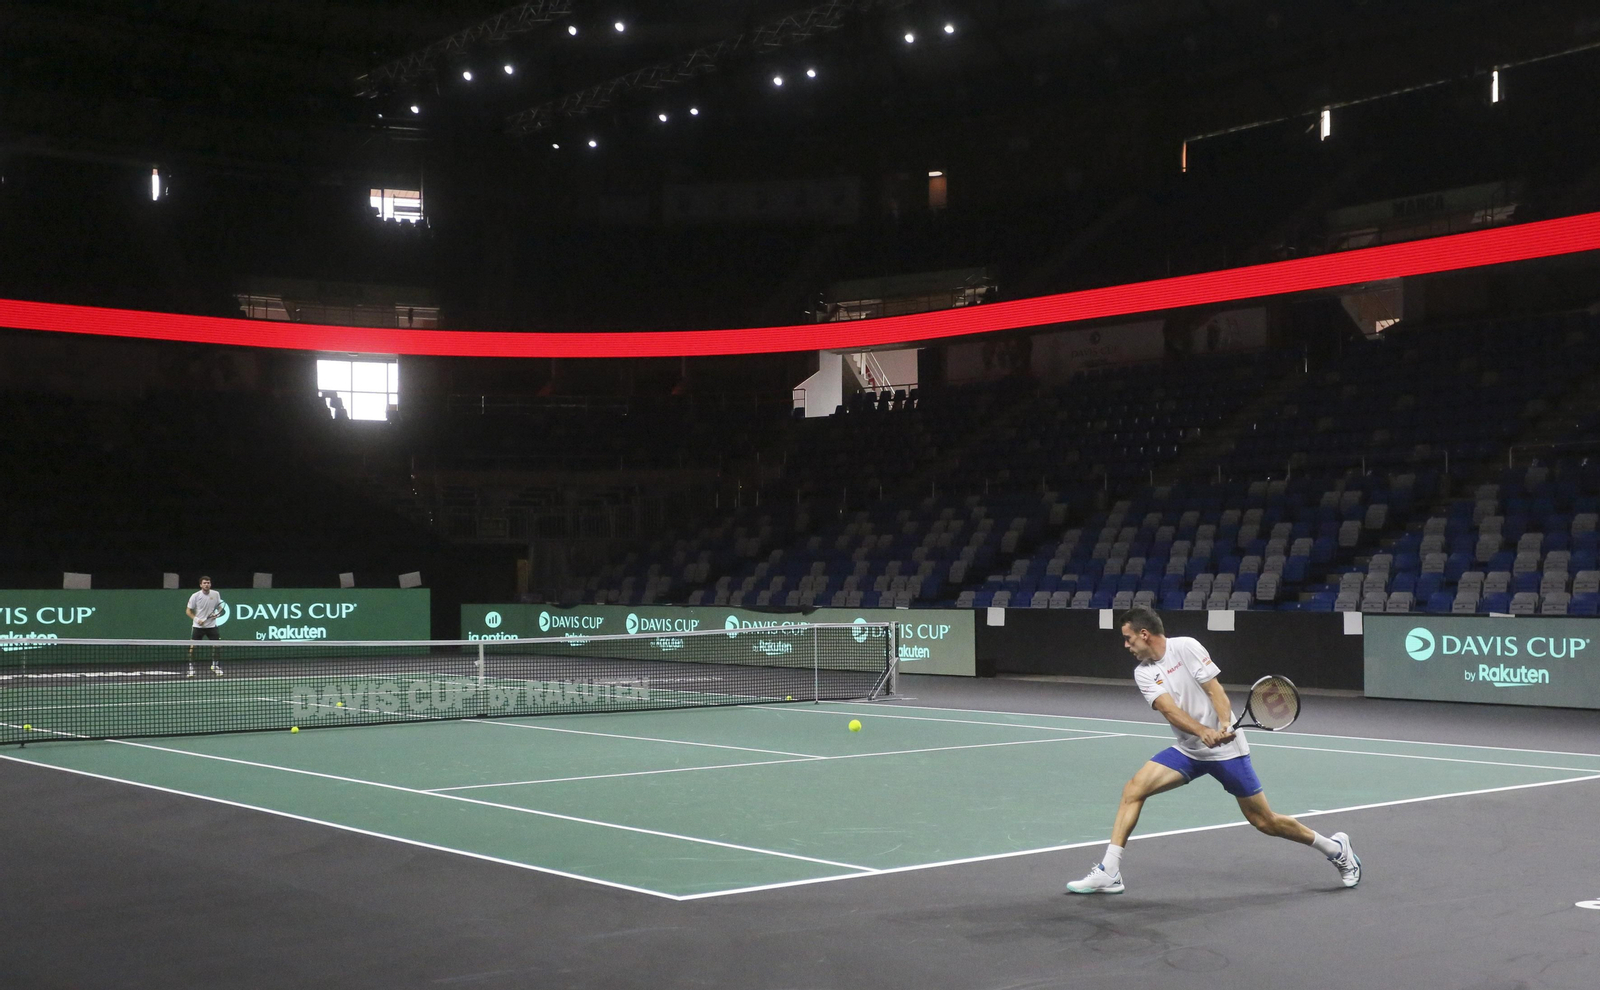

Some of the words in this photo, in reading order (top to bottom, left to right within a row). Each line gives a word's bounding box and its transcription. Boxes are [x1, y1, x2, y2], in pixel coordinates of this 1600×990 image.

[0, 607, 28, 625] IS
[36, 607, 92, 624] CUP
[236, 603, 302, 620] DAVIS
[308, 603, 355, 619] CUP
[552, 616, 579, 628] DAVIS
[581, 616, 603, 629] CUP
[641, 618, 672, 631] DAVIS
[674, 619, 698, 632] CUP
[256, 631, 266, 641] by
[268, 625, 327, 640] Rakuten
[917, 624, 949, 639] CUP
[898, 644, 930, 658] akuten
[1442, 635, 1518, 656] DAVIS
[1526, 637, 1587, 658] CUP
[1464, 670, 1476, 682] by
[1479, 664, 1549, 684] Rakuten
[292, 680, 401, 718] DAVIS
[407, 677, 477, 712] CUP
[526, 676, 650, 706] RAKUTEN
